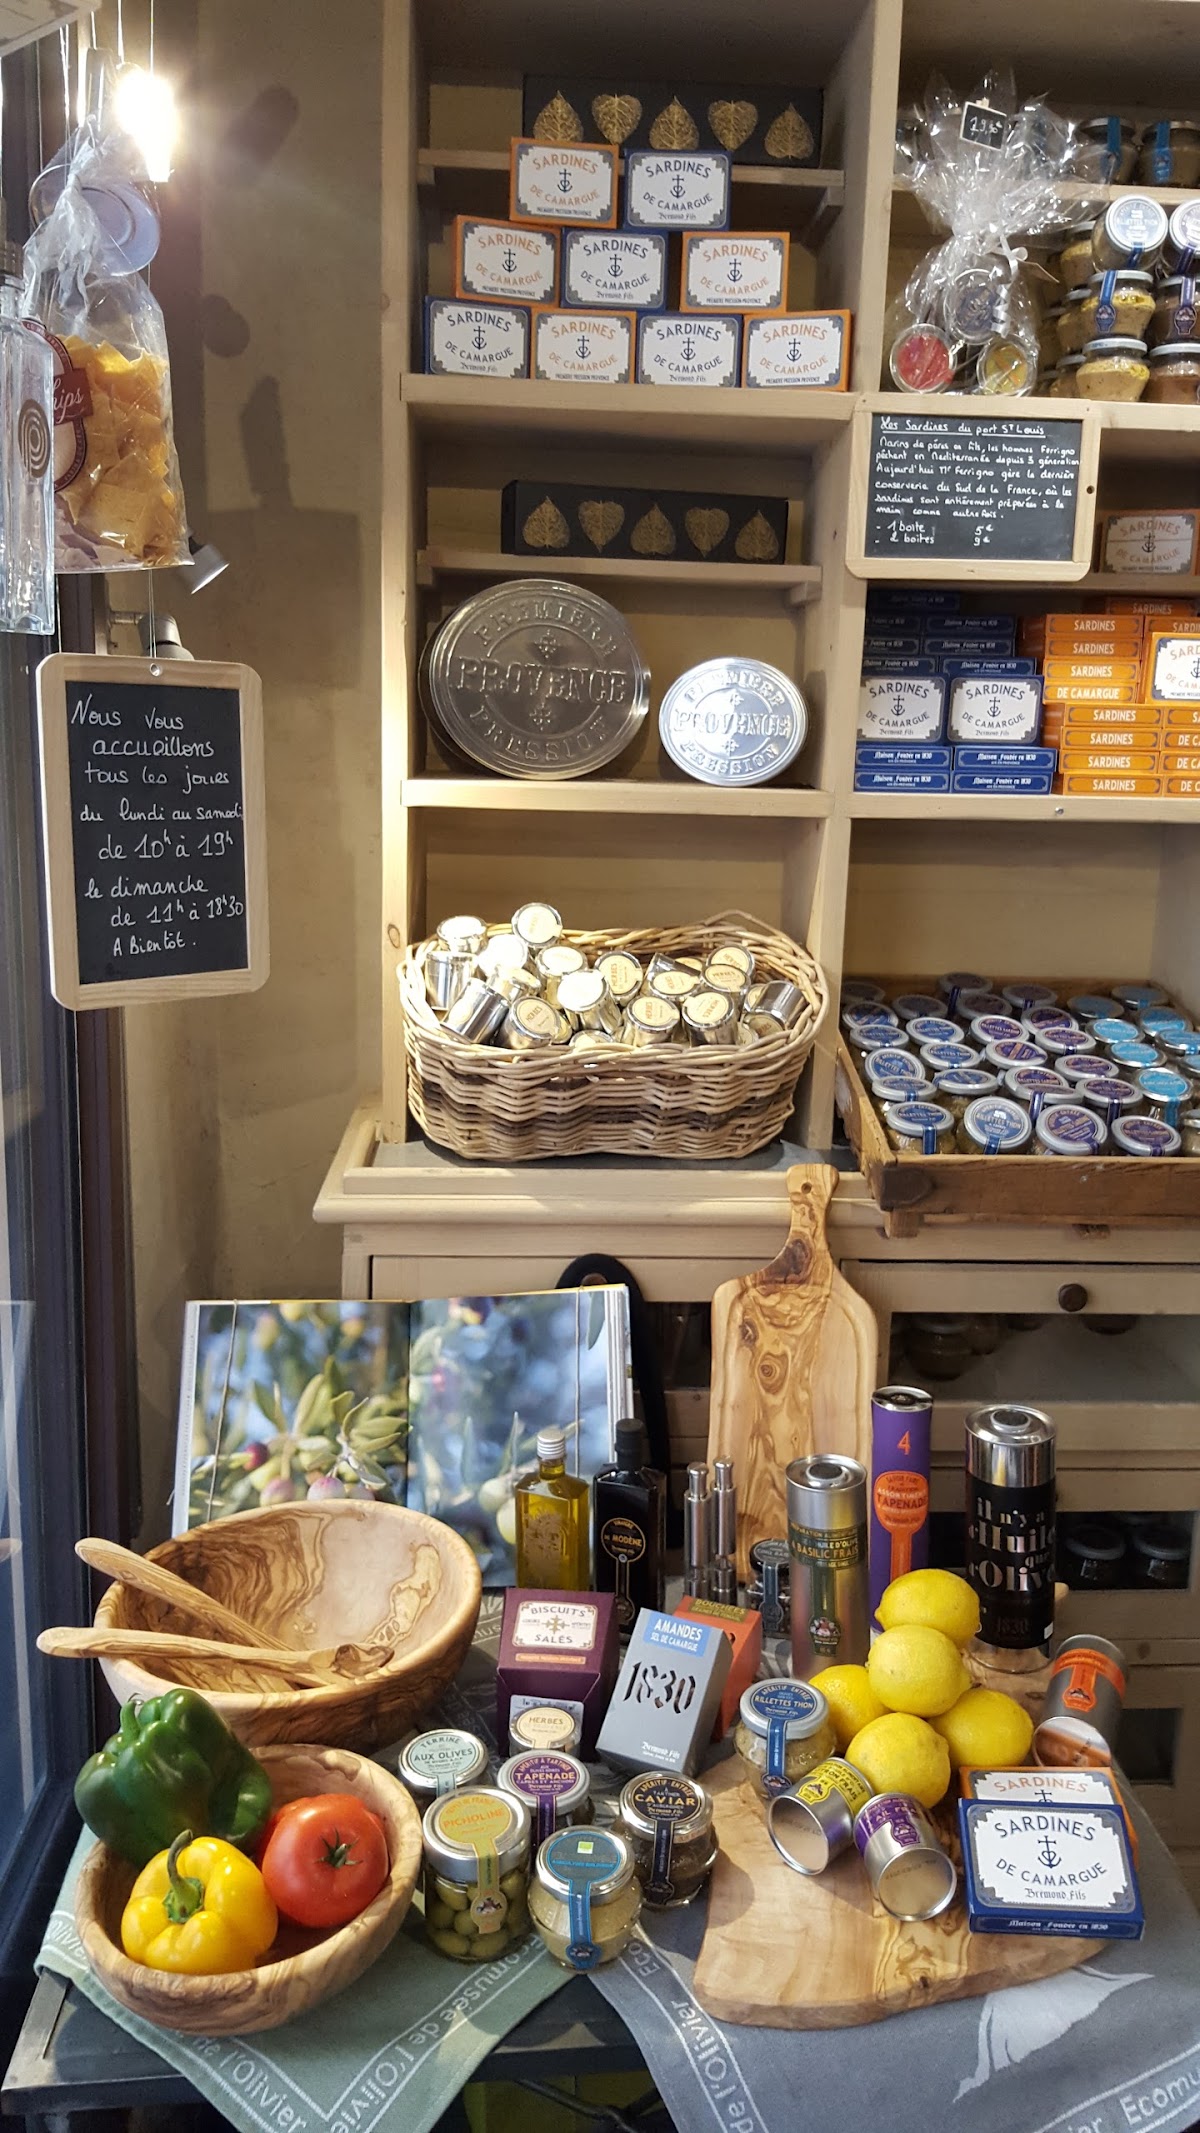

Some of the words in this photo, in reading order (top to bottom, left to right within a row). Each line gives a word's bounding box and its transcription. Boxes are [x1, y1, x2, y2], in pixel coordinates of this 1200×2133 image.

[533, 153, 598, 174] SARDINES
[646, 160, 711, 178] SARDINES
[530, 184, 541, 198] DE
[544, 189, 599, 206] CAMARGUE
[643, 192, 656, 204] DE
[657, 193, 713, 211] CAMARGUE
[478, 233, 541, 256] SARDINES
[583, 239, 648, 259] SARDINES
[702, 244, 768, 263] SARDINES
[475, 263, 487, 276] DE
[490, 271, 543, 286] CAMARGUE
[580, 270, 592, 283] DE
[594, 273, 650, 290] CAMARGUE
[700, 277, 713, 289] DE
[714, 277, 769, 295] CAMARGUE
[447, 311, 511, 332] SARDINES
[551, 321, 616, 340] SARDINES
[656, 324, 721, 342] SARDINES
[763, 323, 828, 342] SARDINES
[445, 341, 456, 354] DE
[459, 347, 514, 363] CAMARGUE
[548, 351, 560, 364] DE
[563, 354, 617, 372] CAMARGUE
[653, 354, 667, 366] DE
[668, 355, 723, 374] CAMARGUE
[760, 357, 772, 368] DE
[774, 356, 828, 376] CAMARGUE
[905, 420, 948, 431] Sardines
[958, 423, 971, 432] du
[913, 439, 925, 448] de
[996, 455, 1024, 466] depuis
[1027, 456, 1034, 464] 3
[1027, 469, 1035, 478] la
[936, 482, 950, 492] du
[976, 484, 986, 493] de
[990, 484, 999, 493] la
[1062, 485, 1072, 496] les
[920, 496, 940, 504] sont
[1055, 499, 1064, 509] la
[887, 520, 896, 531] 1
[889, 530, 899, 542] 2
[1074, 620, 1115, 631] SARDINES
[1073, 643, 1114, 654] SARDINES
[457, 656, 627, 704] PROVENCE
[1071, 665, 1112, 677] SARDINES
[869, 682, 929, 699] SARDINES
[965, 683, 1026, 701] SARDINES
[1057, 687, 1070, 699] DE
[1071, 687, 1119, 699] CAMARGUE
[71, 693, 121, 726] Nous
[865, 710, 876, 722] DE
[878, 712, 930, 728] CAMARGUE
[1093, 709, 1136, 722] SARDINES
[674, 709, 791, 738] PROVENCE
[962, 711, 973, 723] DE
[974, 713, 1026, 728] CAMARGUE
[93, 736, 215, 757] accueillons
[1090, 733, 1133, 745] SARDINES
[680, 740, 781, 775] PRESSION
[1088, 756, 1130, 768] SARDINES
[84, 761, 129, 783] tous
[142, 766, 167, 784] les
[1092, 779, 1135, 791] SARDINES
[80, 804, 103, 821] du
[120, 797, 165, 820] lundi
[172, 808, 192, 820] au
[98, 834, 127, 859] de
[175, 834, 190, 857] à
[85, 878, 103, 898] le
[111, 875, 208, 897] dimanche
[111, 906, 136, 927] de
[189, 902, 200, 920] à
[113, 937, 122, 956] A
[896, 1430, 911, 1455] 4
[531, 1605, 586, 1617] BISCUITS
[654, 1618, 703, 1641] AMANDES
[651, 1632, 660, 1641] SEL
[660, 1635, 668, 1643] DE
[668, 1636, 698, 1652] CAMARGUE
[623, 1661, 696, 1714] 1830
[755, 1695, 791, 1706] RILLETTES
[793, 1700, 813, 1709] THON
[528, 1716, 564, 1725] HERBES
[421, 1735, 460, 1749] TERRINE
[414, 1752, 436, 1762] AUX
[438, 1748, 473, 1759] OLIVES
[514, 1772, 576, 1780] TAPENADE
[994, 1776, 1088, 1793] SARDINES
[634, 1793, 696, 1806] CAVIAR
[443, 1808, 504, 1828] PICHOLINE
[994, 1815, 1096, 1841] SARDINES
[996, 1858, 1017, 1876] DE
[1021, 1862, 1107, 1887] CAMARGUE
[1025, 1888, 1066, 1899] Bremond
[408, 2022, 441, 2045] de
